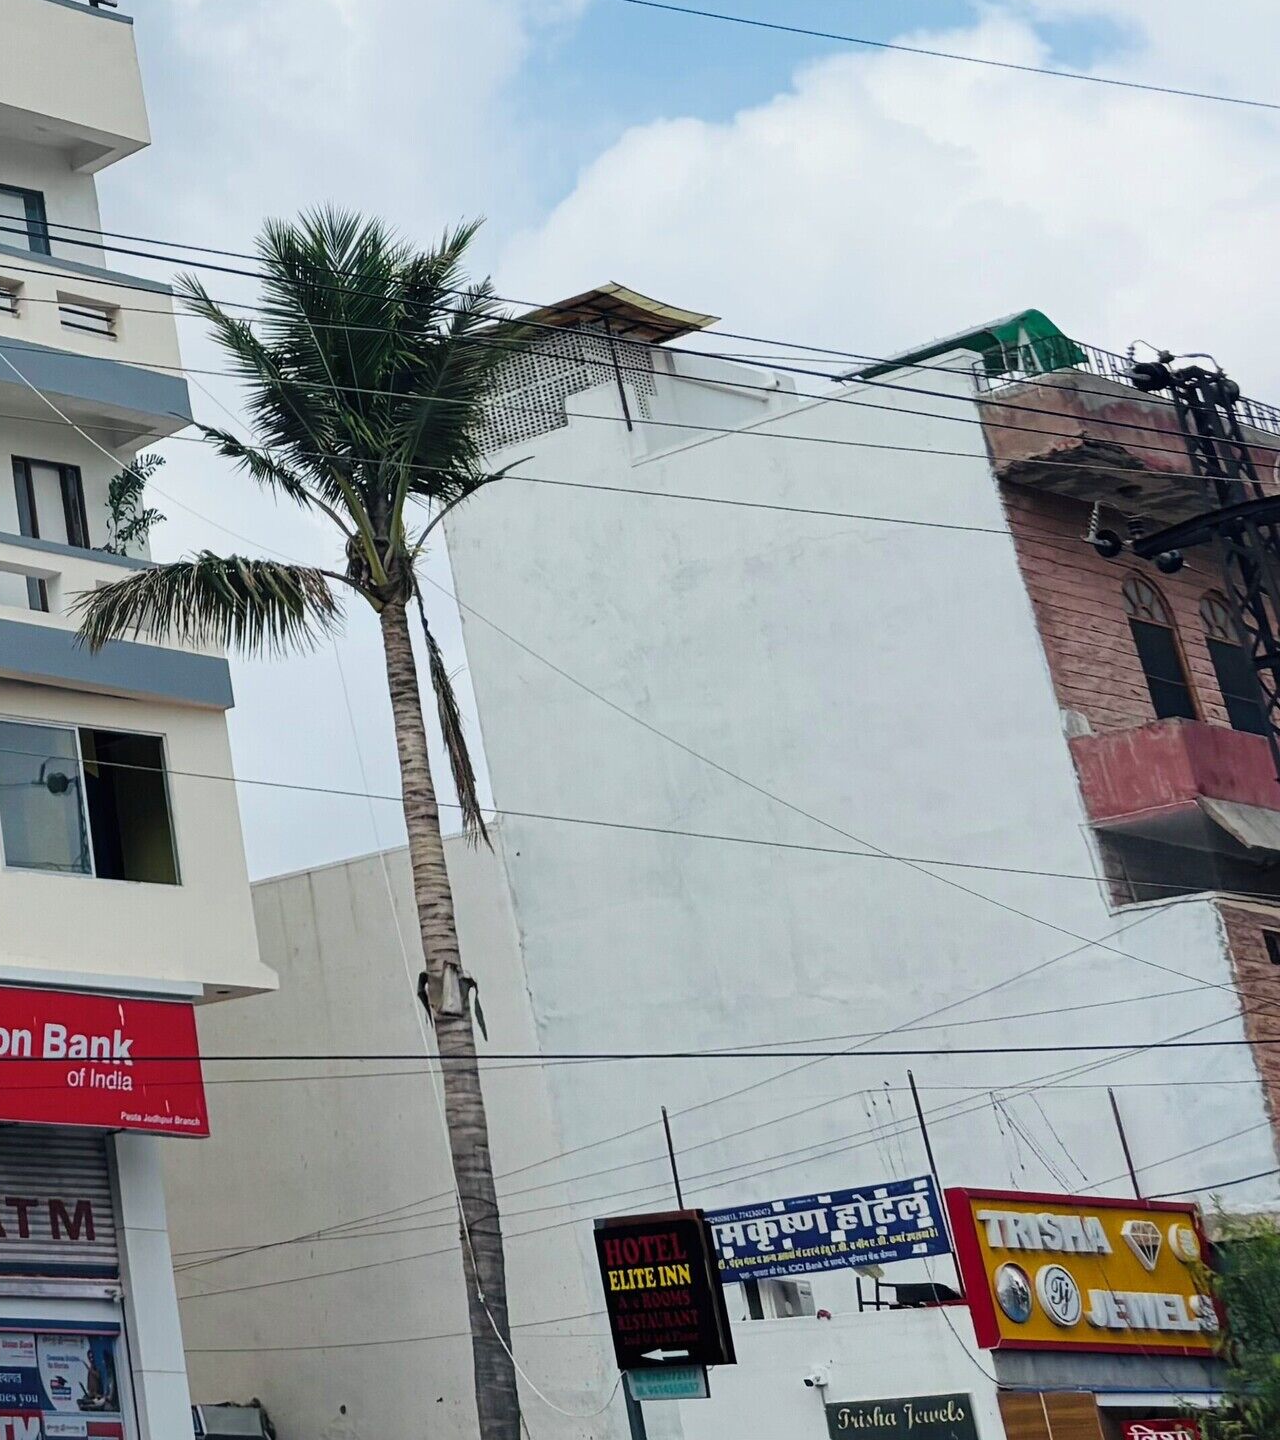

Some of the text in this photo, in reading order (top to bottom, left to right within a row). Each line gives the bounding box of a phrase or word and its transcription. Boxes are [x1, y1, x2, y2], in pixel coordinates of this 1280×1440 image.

[43, 1023, 134, 1066] Bank
[67, 1068, 133, 1092] of India
[174, 1116, 201, 1127] Branch
[711, 1193, 930, 1252] ामकृष्ण होटल
[976, 1209, 1113, 1254] TRISHA
[604, 1233, 687, 1266] HOTEL
[608, 1264, 692, 1291] ELITE INN
[806, 1260, 822, 1270] Bank
[642, 1290, 690, 1308] ROOMS
[1084, 1289, 1219, 1331] JEWELS
[617, 1310, 699, 1330] RESTAURANT
[18, 1392, 38, 1407] you
[837, 1401, 965, 1430] Trisha Jewels
